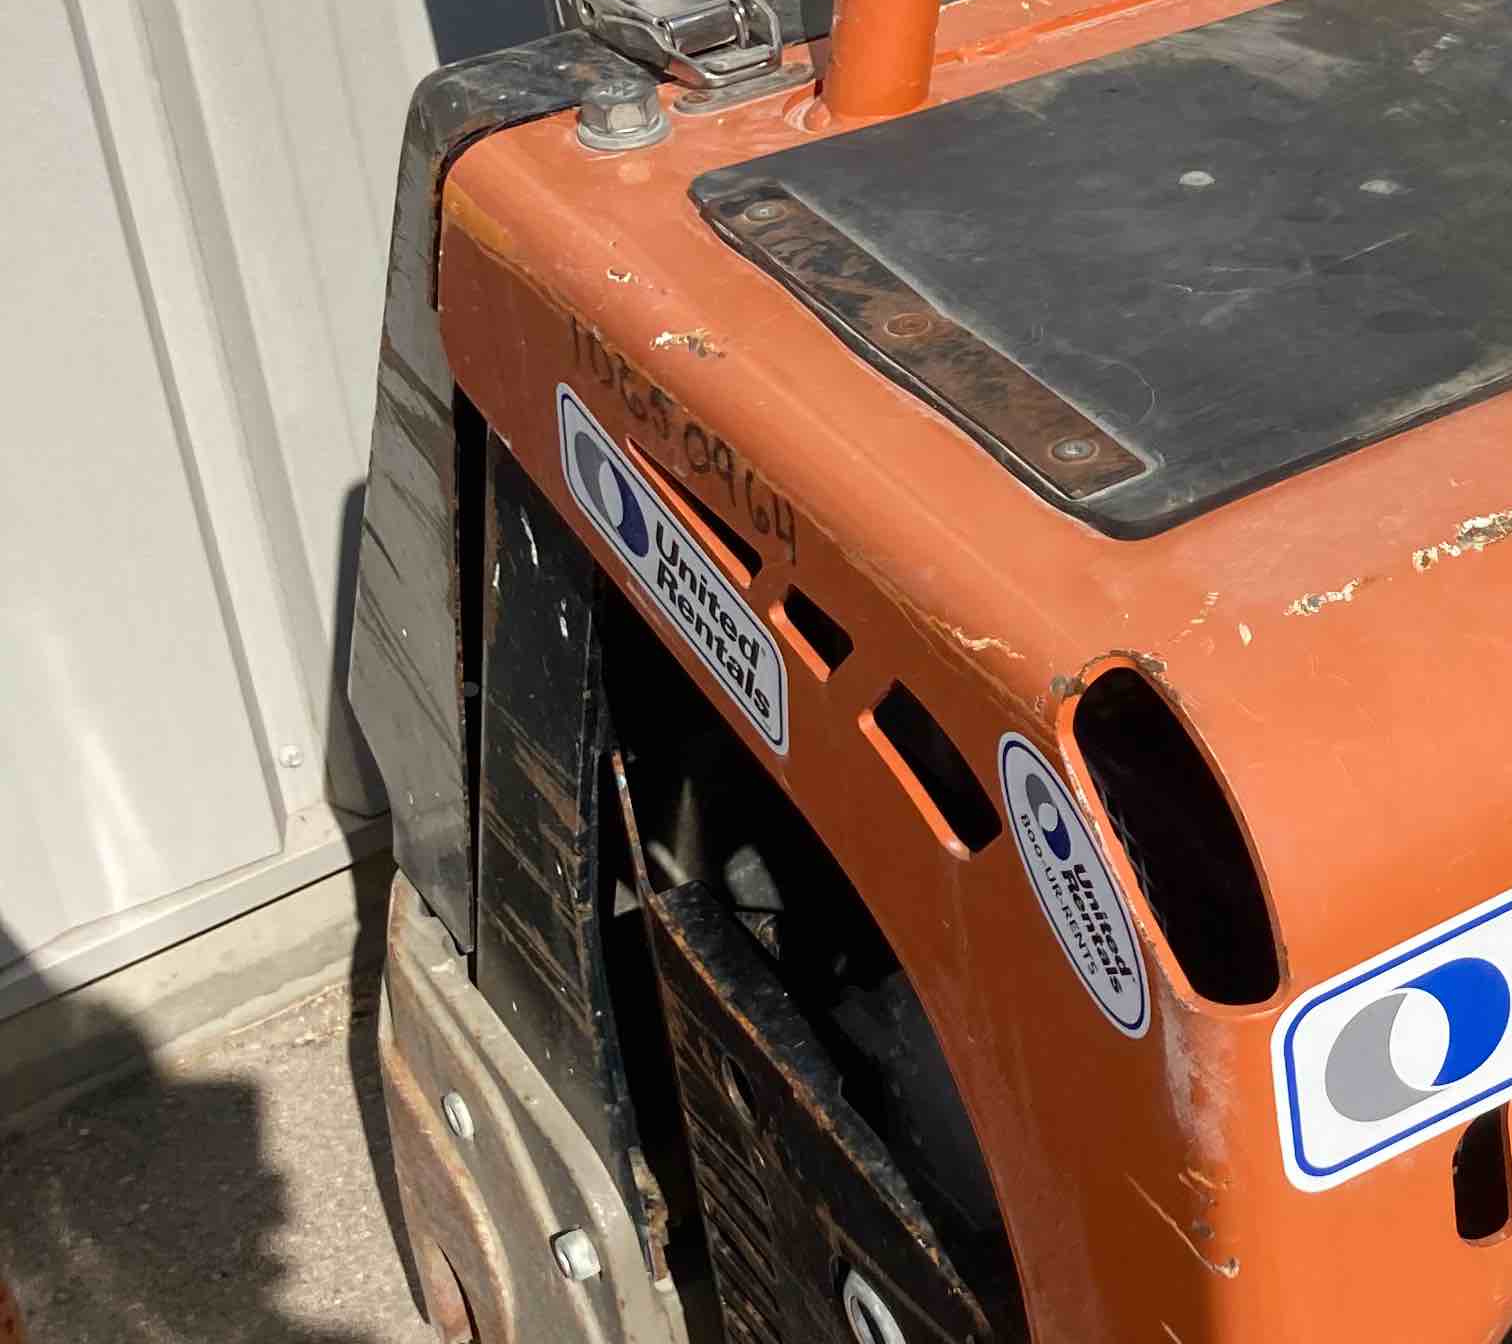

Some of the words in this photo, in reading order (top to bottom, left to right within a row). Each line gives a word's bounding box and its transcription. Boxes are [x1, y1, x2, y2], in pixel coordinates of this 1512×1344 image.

[656, 520, 761, 669] United
[657, 557, 771, 719] Rentals
[1020, 814, 1099, 975] 800-UR-RENTS
[1061, 869, 1122, 994] Rentals
[1074, 863, 1132, 977] United
